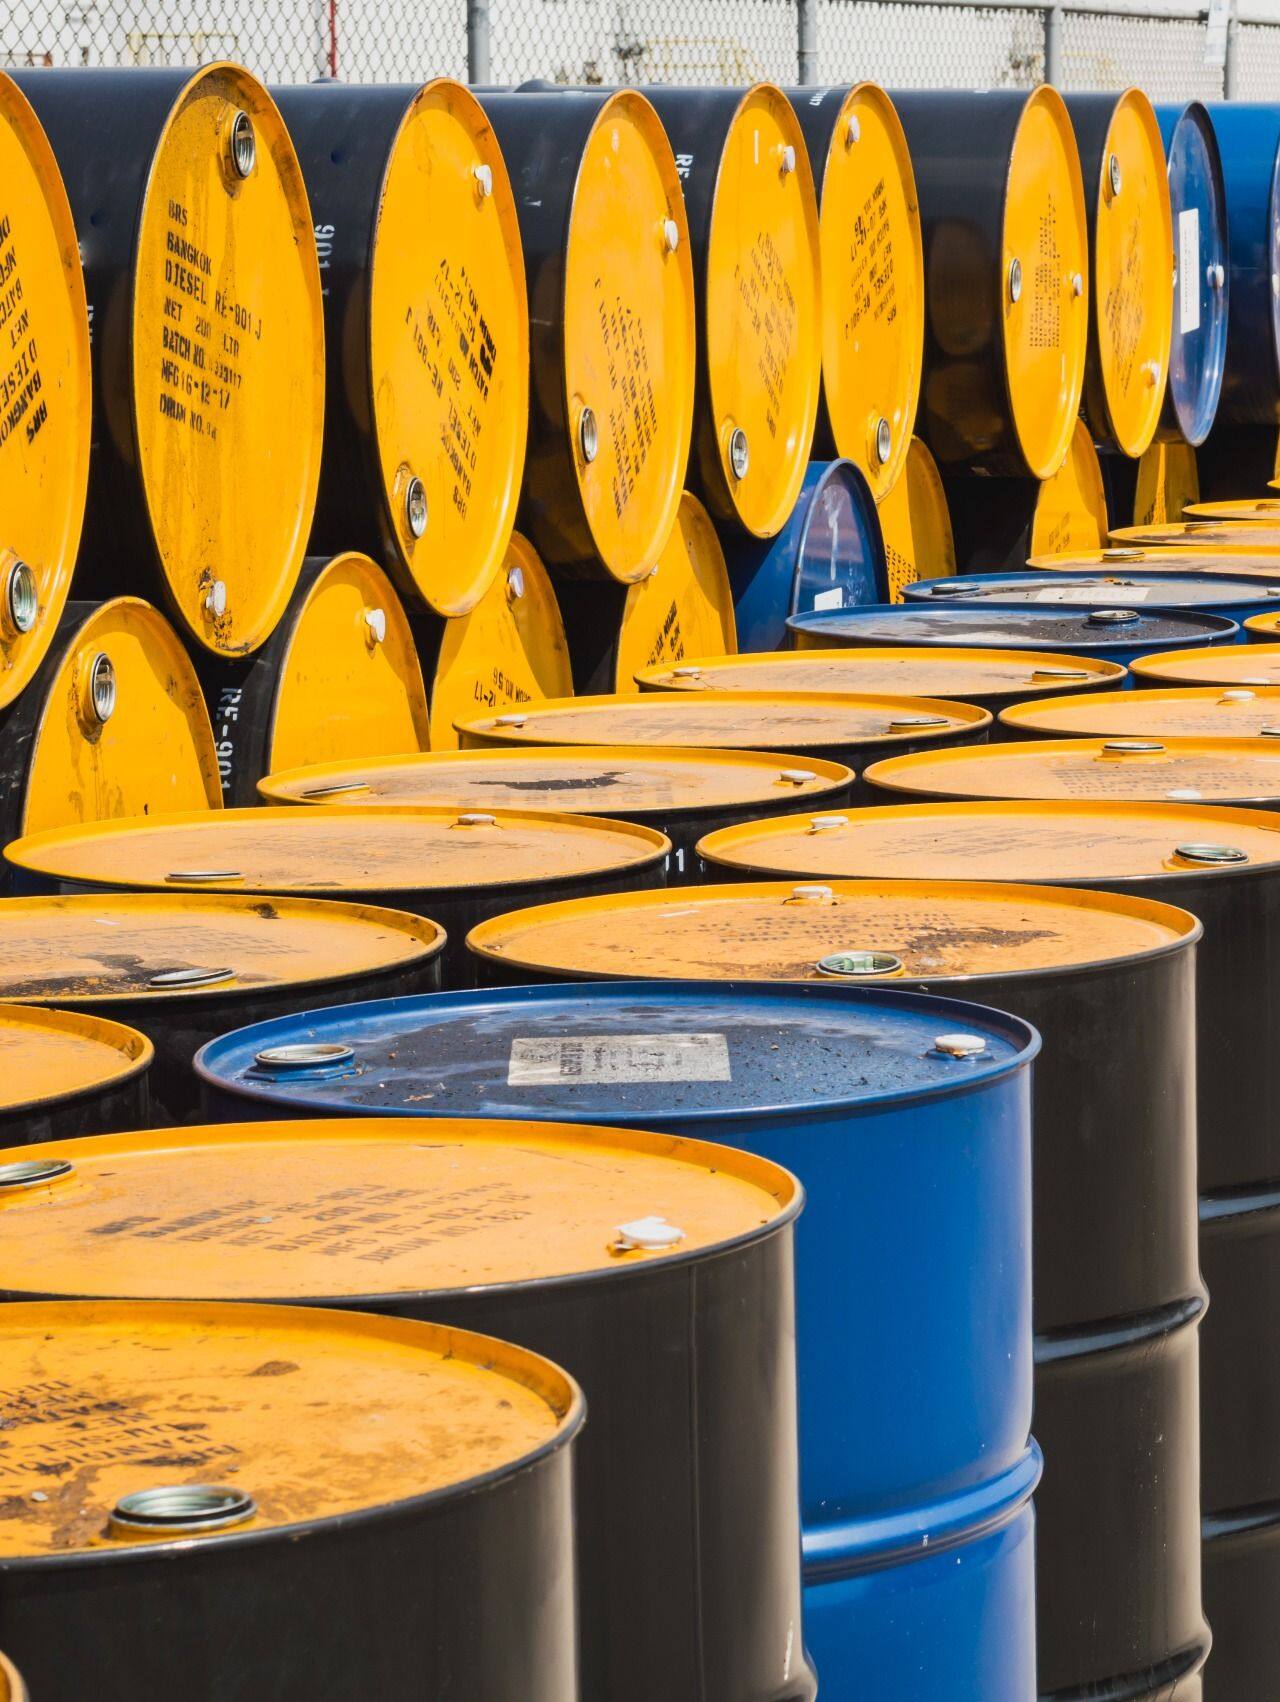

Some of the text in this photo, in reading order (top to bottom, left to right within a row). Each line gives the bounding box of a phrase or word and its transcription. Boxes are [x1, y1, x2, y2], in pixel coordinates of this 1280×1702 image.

[168, 201, 187, 225] BRS
[167, 232, 210, 274] BANGKOK
[165, 260, 205, 303] DIESEL
[0, 277, 23, 330] BATC
[10, 308, 29, 350] NET
[163, 327, 190, 359] BATCH
[164, 297, 182, 321] NET
[223, 334, 239, 356] LTR
[0, 338, 38, 412] DIESE
[0, 369, 42, 447] BANGKO
[26, 400, 48, 445] BRS
[160, 394, 185, 421] DRUM
[449, 399, 475, 468] DIESEL
[221, 1230, 282, 1246] NET
[303, 1206, 363, 1221] 200
[266, 1225, 359, 1251] BATCH
[313, 1238, 377, 1256] MFG
[356, 1238, 437, 1261] DRUM
